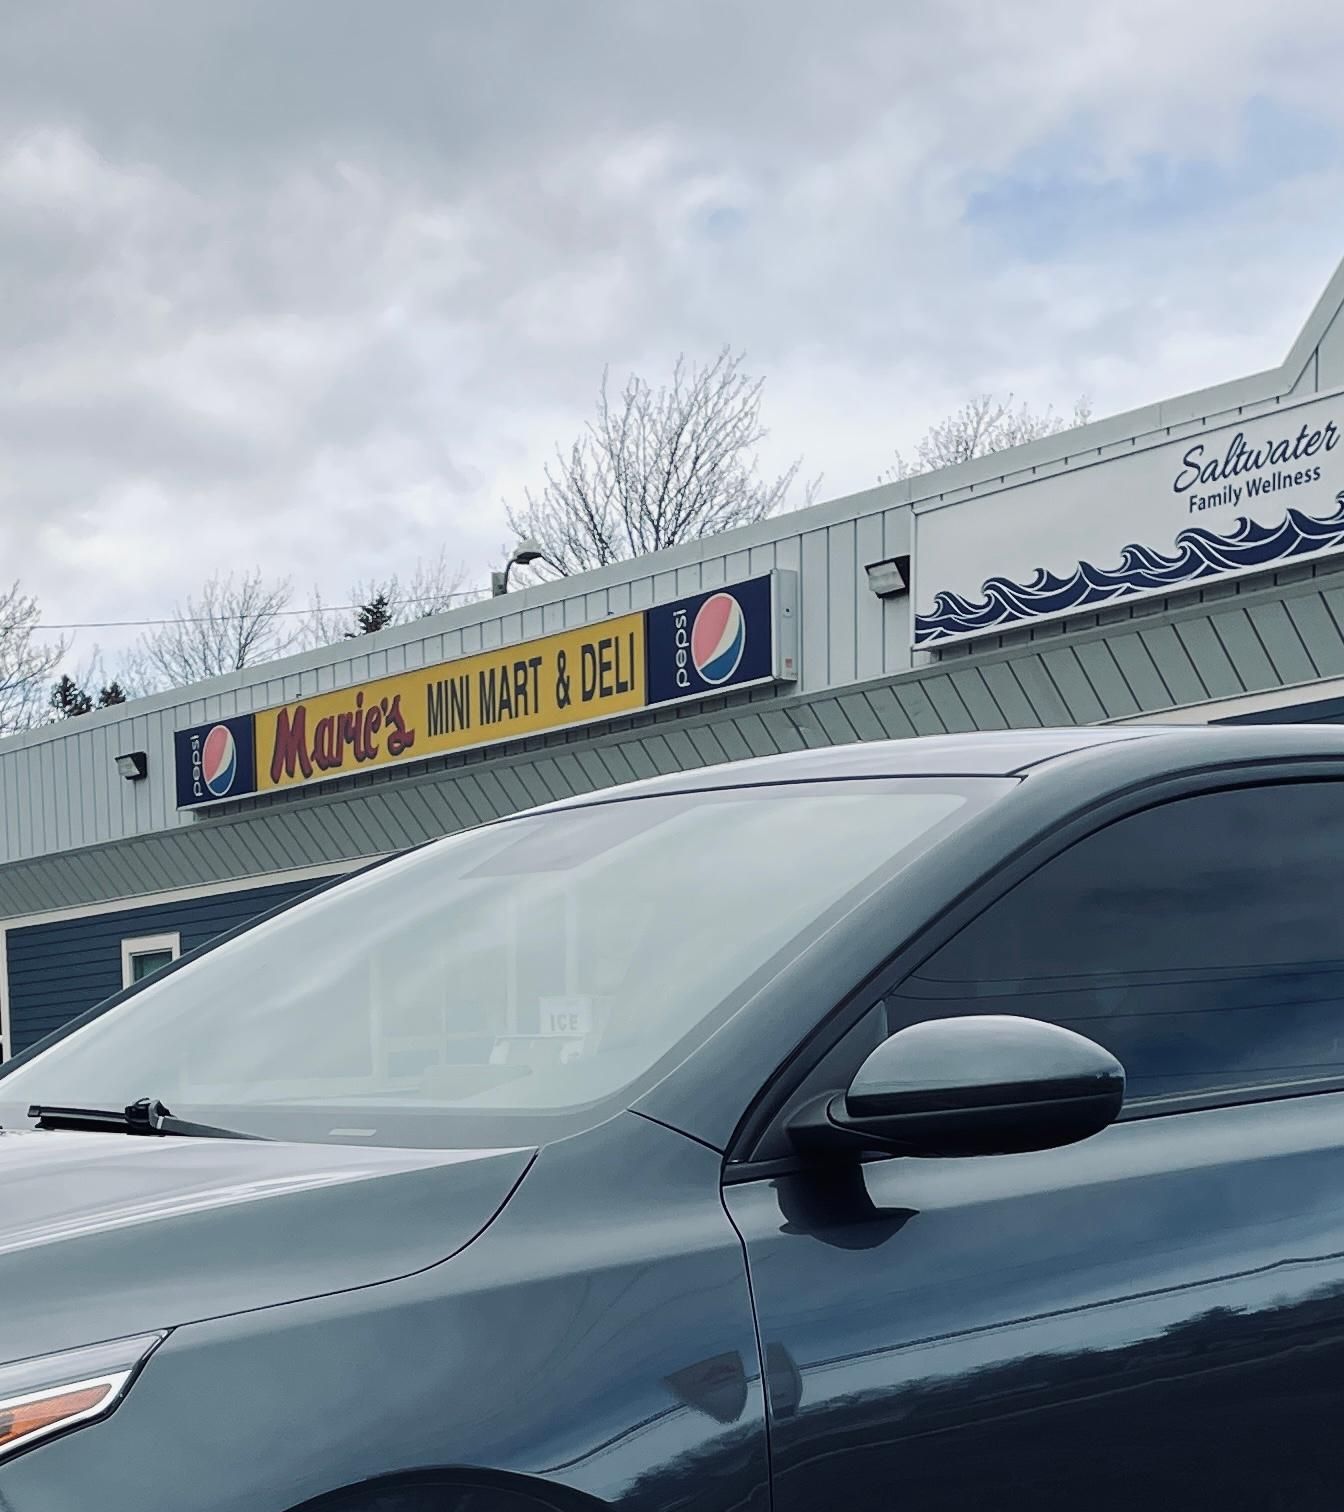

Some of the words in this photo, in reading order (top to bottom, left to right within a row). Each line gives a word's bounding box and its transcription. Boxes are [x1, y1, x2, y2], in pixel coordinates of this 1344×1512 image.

[1173, 419, 1341, 493] Saltwater
[1189, 484, 1243, 514] Family
[1246, 466, 1321, 498] Wellness
[674, 608, 692, 689] pepsi
[270, 691, 416, 785] Marie's
[426, 674, 471, 738] MINI
[479, 655, 543, 726] MART
[556, 649, 571, 709] &
[581, 631, 636, 702] DELI
[189, 734, 204, 798] pepsi
